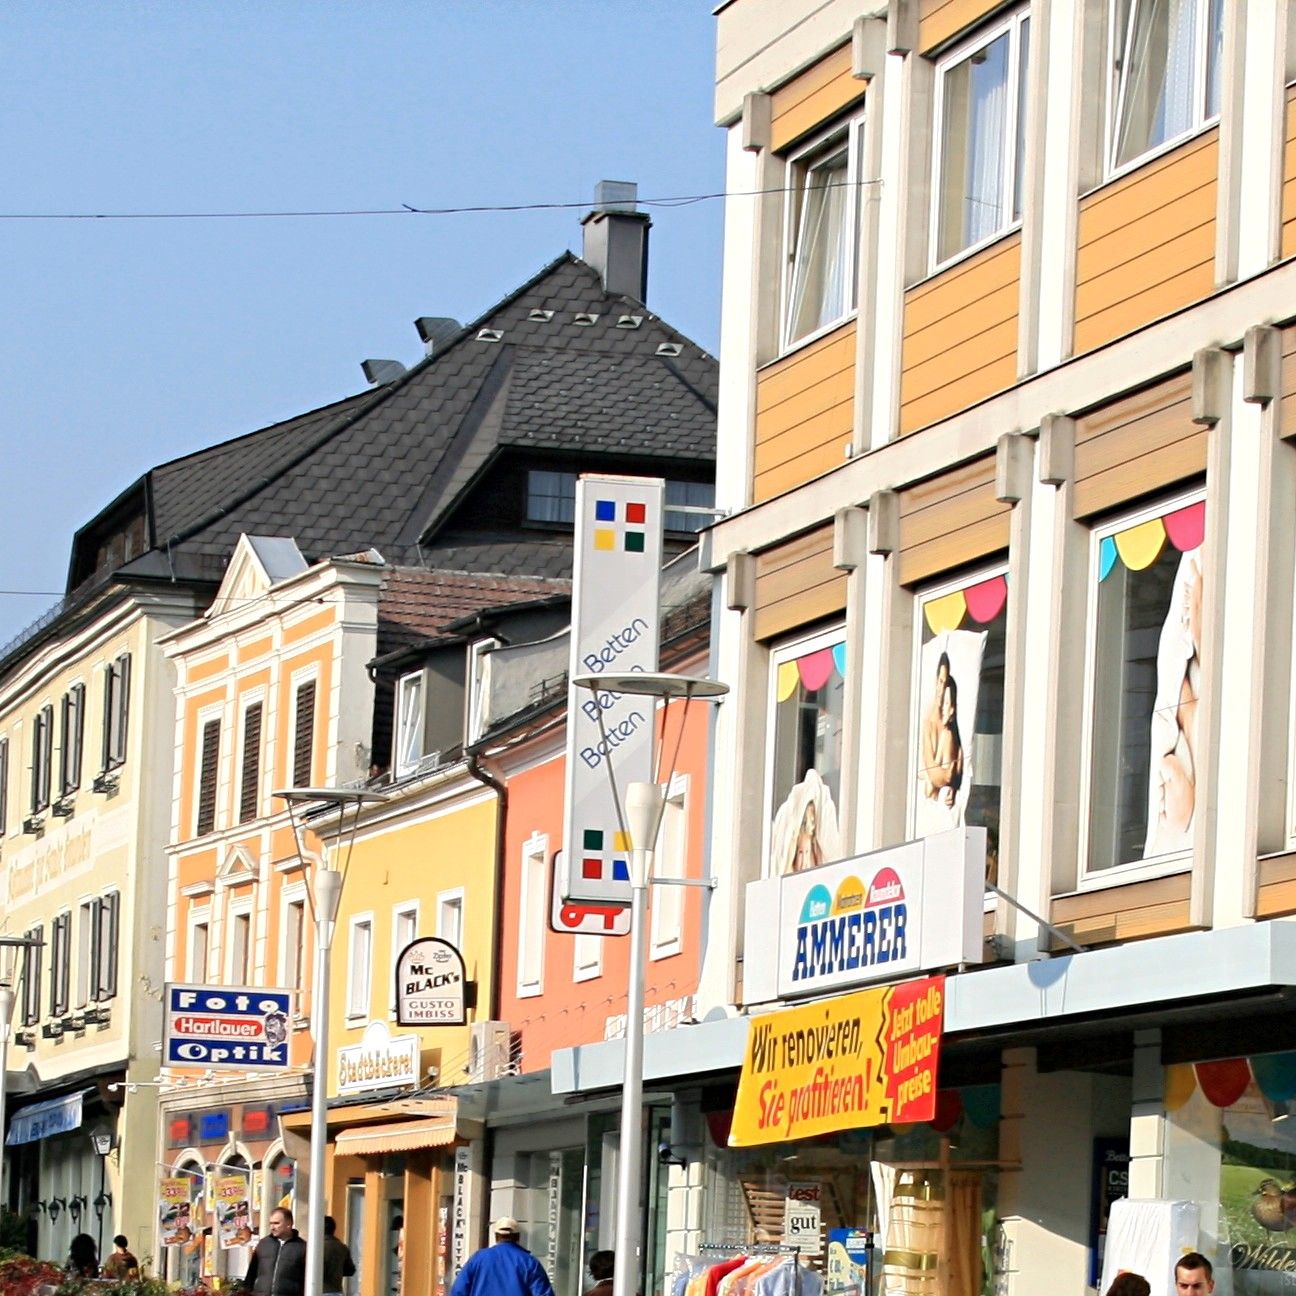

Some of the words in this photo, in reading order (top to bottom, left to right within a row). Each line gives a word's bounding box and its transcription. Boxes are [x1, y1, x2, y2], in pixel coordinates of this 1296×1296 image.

[583, 616, 650, 674] Betten
[579, 709, 646, 770] Betten
[791, 903, 908, 982] AMMERER
[179, 992, 279, 1012] Foto
[409, 1000, 455, 1009] GUSTO
[409, 1010, 455, 1019] IMBISS
[915, 985, 942, 1026] tolle
[180, 1017, 257, 1036] Hartlauer
[751, 1023, 778, 1074] Wir
[782, 1009, 864, 1069] renovieren,
[177, 1043, 282, 1062] Optik
[893, 1031, 938, 1074] Umbau-
[758, 1080, 785, 1130] Sie
[786, 1057, 873, 1138] profitieren!
[896, 1066, 932, 1116] preise
[789, 1185, 820, 1201] test
[790, 1215, 817, 1235] gut
